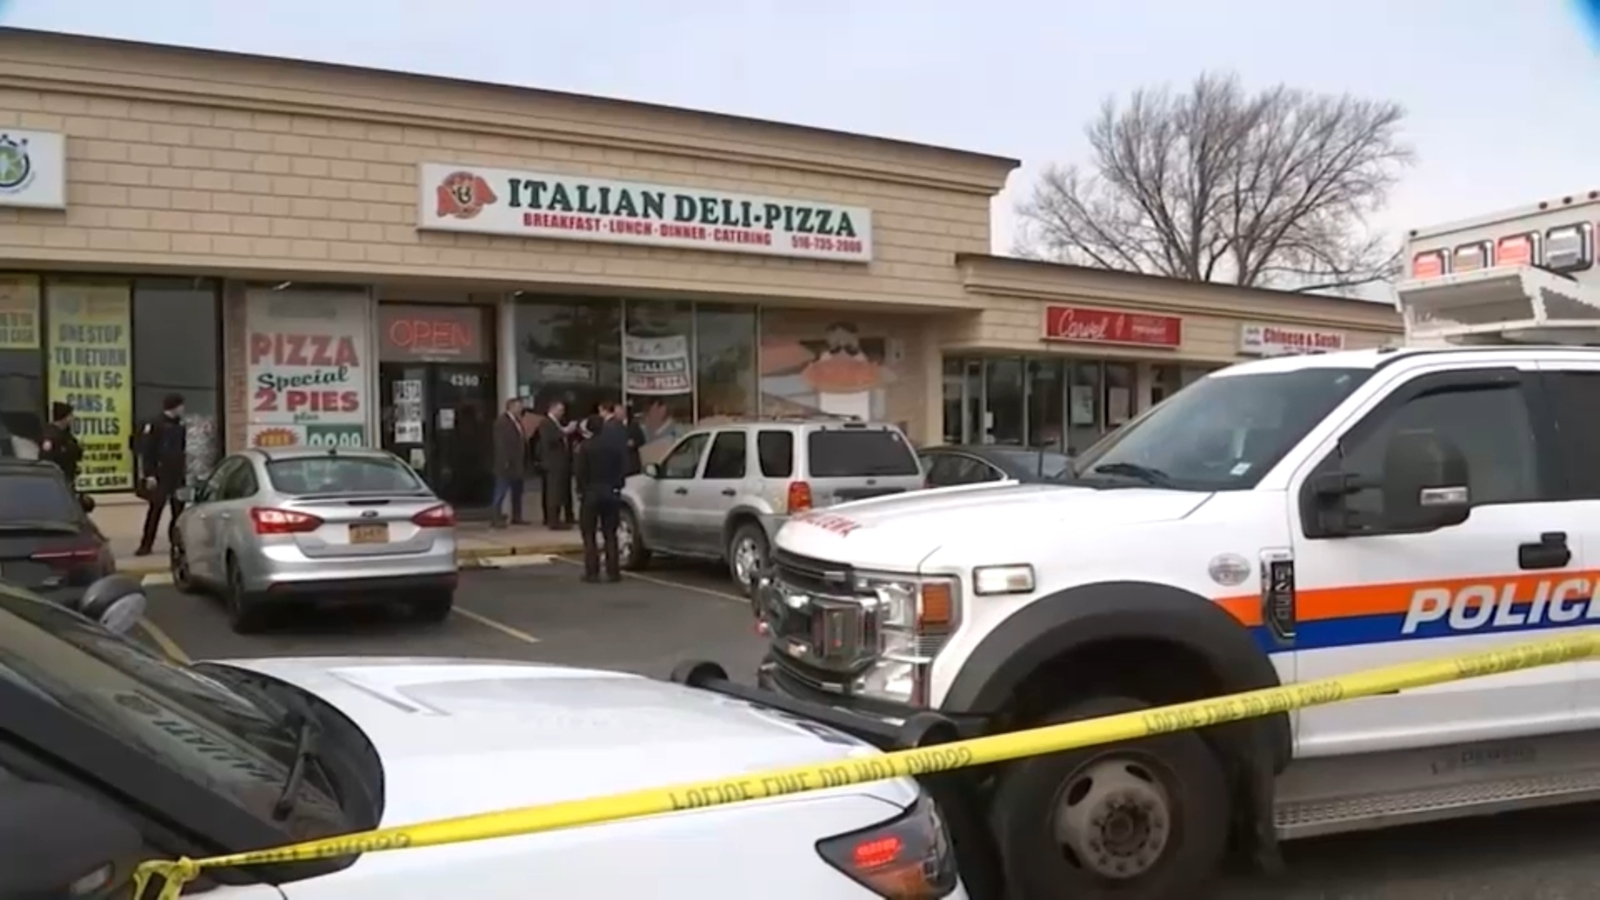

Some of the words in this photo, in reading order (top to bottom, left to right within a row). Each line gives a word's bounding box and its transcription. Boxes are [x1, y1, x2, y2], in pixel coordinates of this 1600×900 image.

[508, 177, 666, 220] ITALIAN
[523, 212, 601, 232] BREAKFAST
[609, 218, 653, 236] LUNCH
[660, 224, 706, 240] DINNER
[713, 228, 772, 246] CATERING
[86, 324, 122, 344] STOP
[389, 318, 472, 347] OPEN
[1059, 308, 1109, 340] Carvel
[250, 332, 360, 367] PIZZA
[1263, 327, 1305, 346] Chinese
[1314, 332, 1341, 349] Sushi
[54, 346, 72, 365] TO
[75, 347, 127, 368] RETURN
[59, 370, 82, 389] ALL
[257, 366, 349, 393] Special
[253, 386, 279, 412] 2
[286, 390, 360, 413] PIES
[73, 416, 120, 436] OTTLES
[96, 475, 128, 487] CASH
